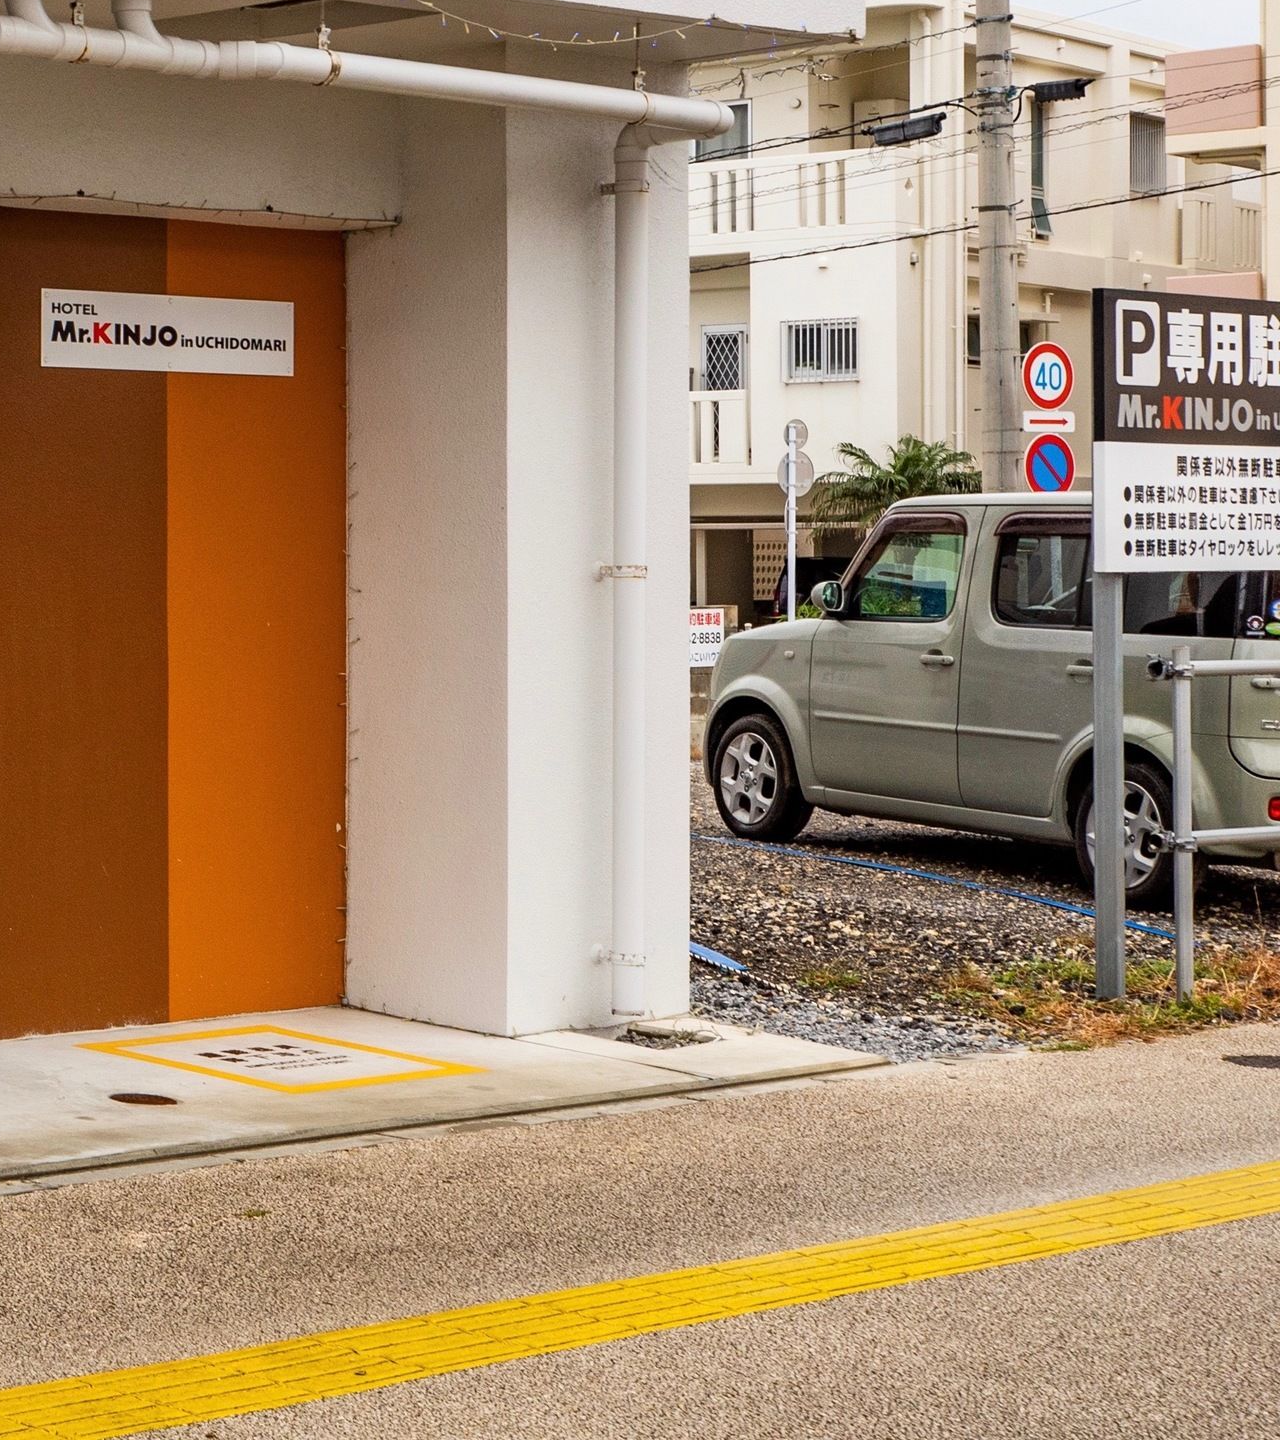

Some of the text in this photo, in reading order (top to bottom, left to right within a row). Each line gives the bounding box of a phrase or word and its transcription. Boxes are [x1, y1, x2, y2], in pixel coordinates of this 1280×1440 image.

[51, 303, 98, 315] HOTEL
[51, 320, 286, 352] Mr.KINJO in UCHIDOMARI
[1035, 362, 1062, 390] 40
[1118, 394, 1253, 432] Mr.KINJO
[1256, 409, 1270, 430] in
[1134, 485, 1280, 505] 関係者以外の駐車はご遠慮下さ
[690, 632, 721, 644] 2-8838
